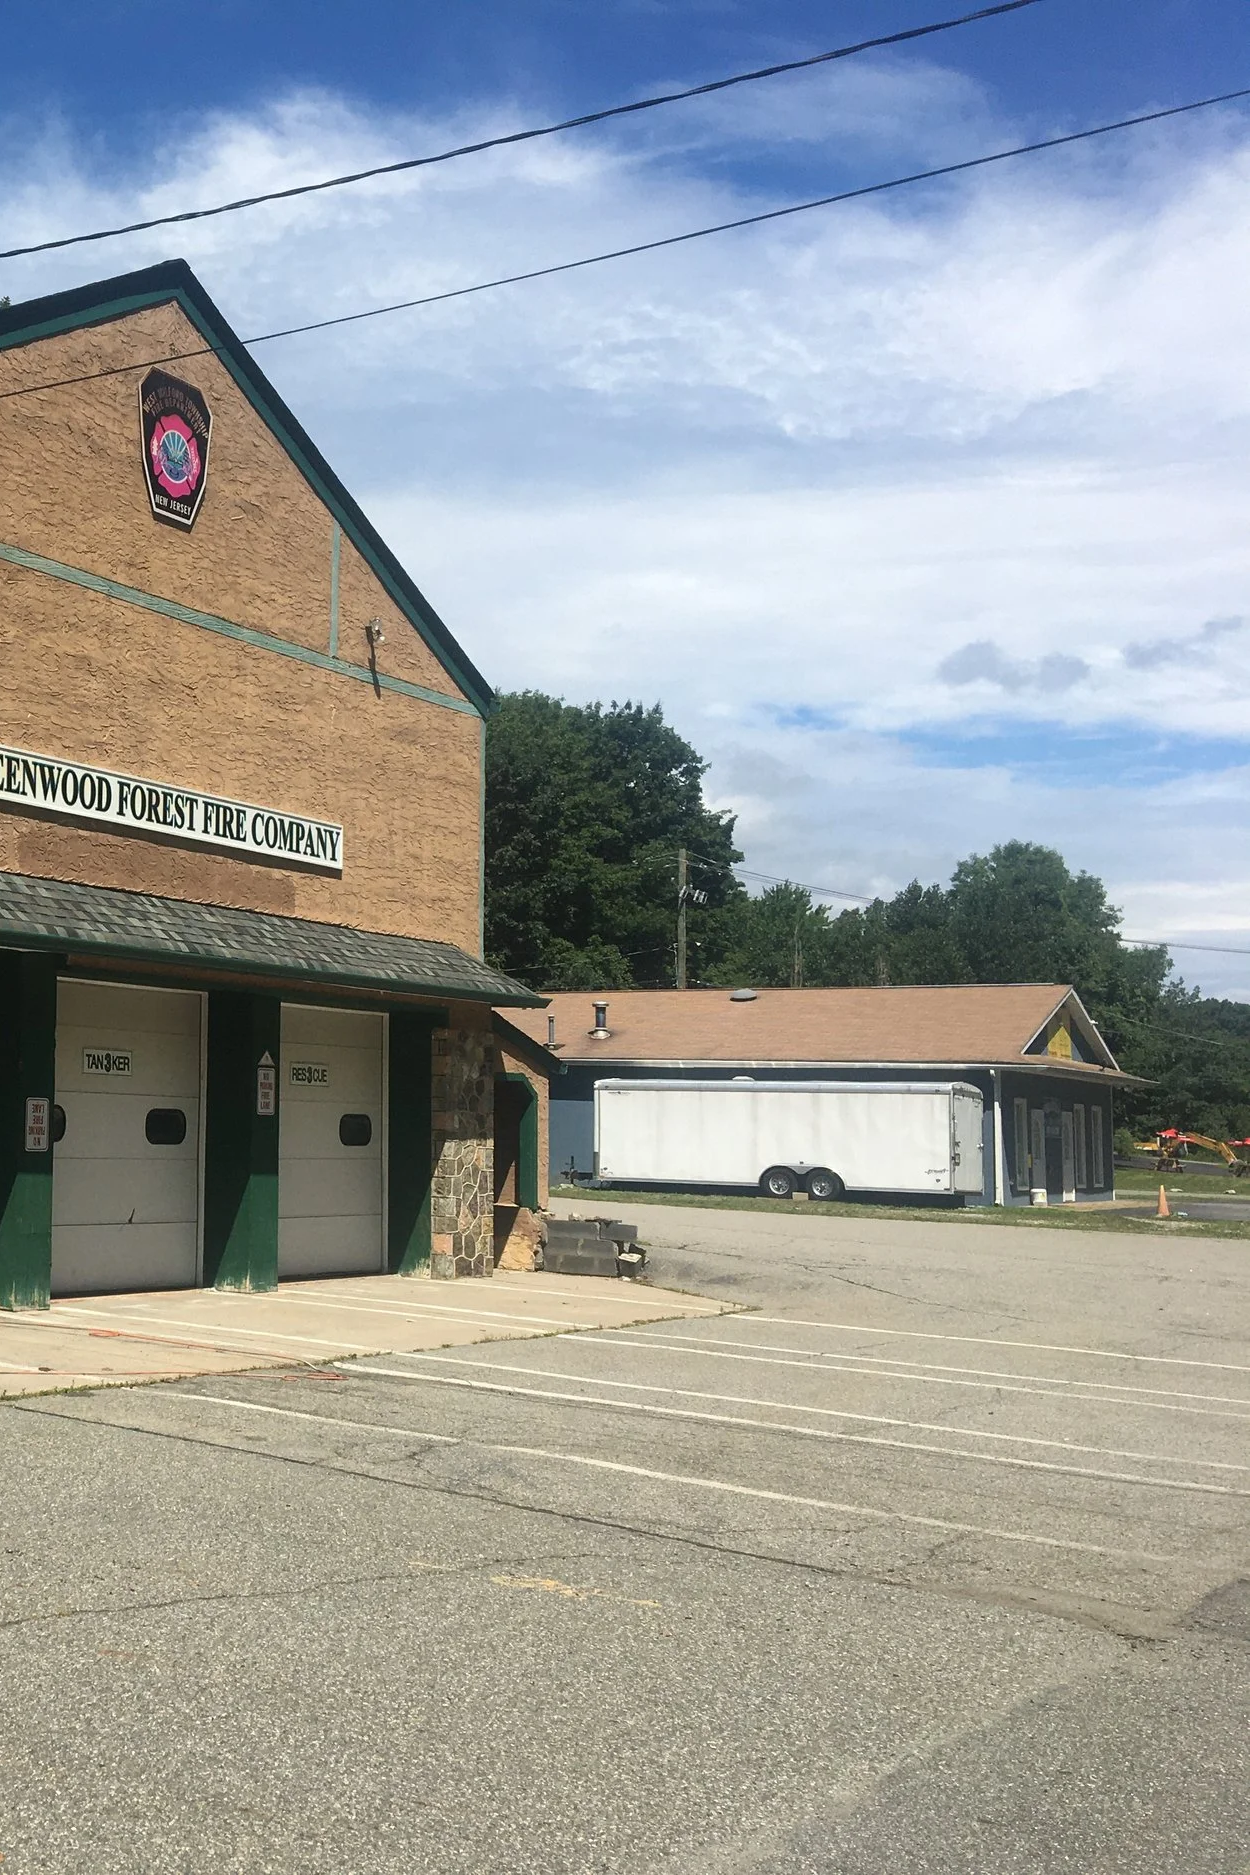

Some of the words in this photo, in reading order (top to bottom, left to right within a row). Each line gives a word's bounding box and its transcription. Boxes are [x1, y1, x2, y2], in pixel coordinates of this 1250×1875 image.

[142, 391, 157, 413] WEST
[155, 494, 169, 507] NEW
[169, 499, 192, 515] JERSEY
[117, 782, 198, 831] FOREST
[202, 800, 248, 842] FIRE
[251, 811, 340, 862] COMPANY
